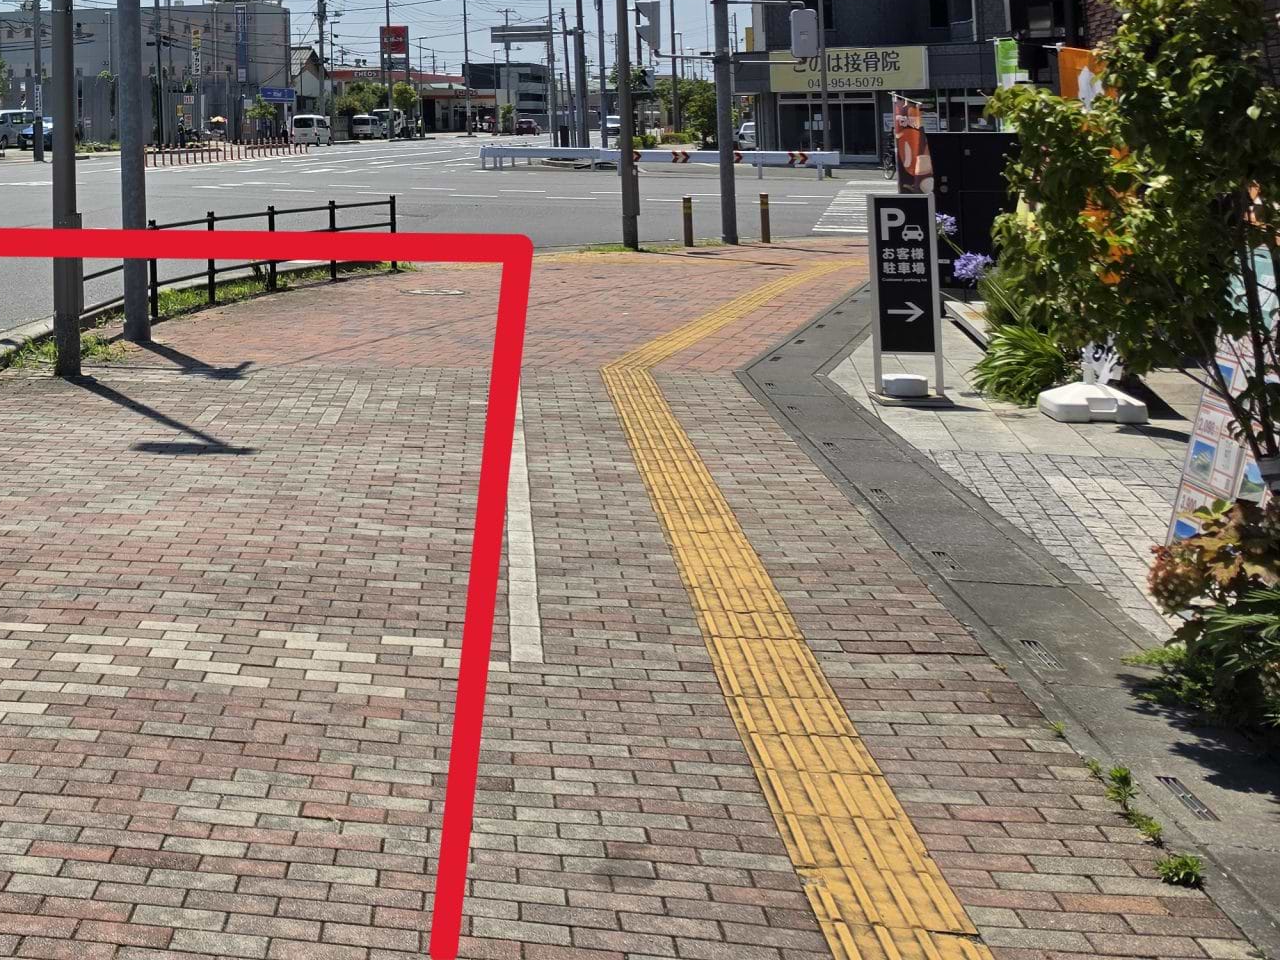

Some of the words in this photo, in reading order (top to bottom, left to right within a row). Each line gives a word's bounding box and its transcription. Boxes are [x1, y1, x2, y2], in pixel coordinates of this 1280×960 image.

[807, 76, 884, 89] 04-954-5079
[454, 89, 479, 97] ENOS
[880, 207, 906, 241] P
[882, 247, 925, 260] お客様
[882, 261, 926, 275] 駐車場
